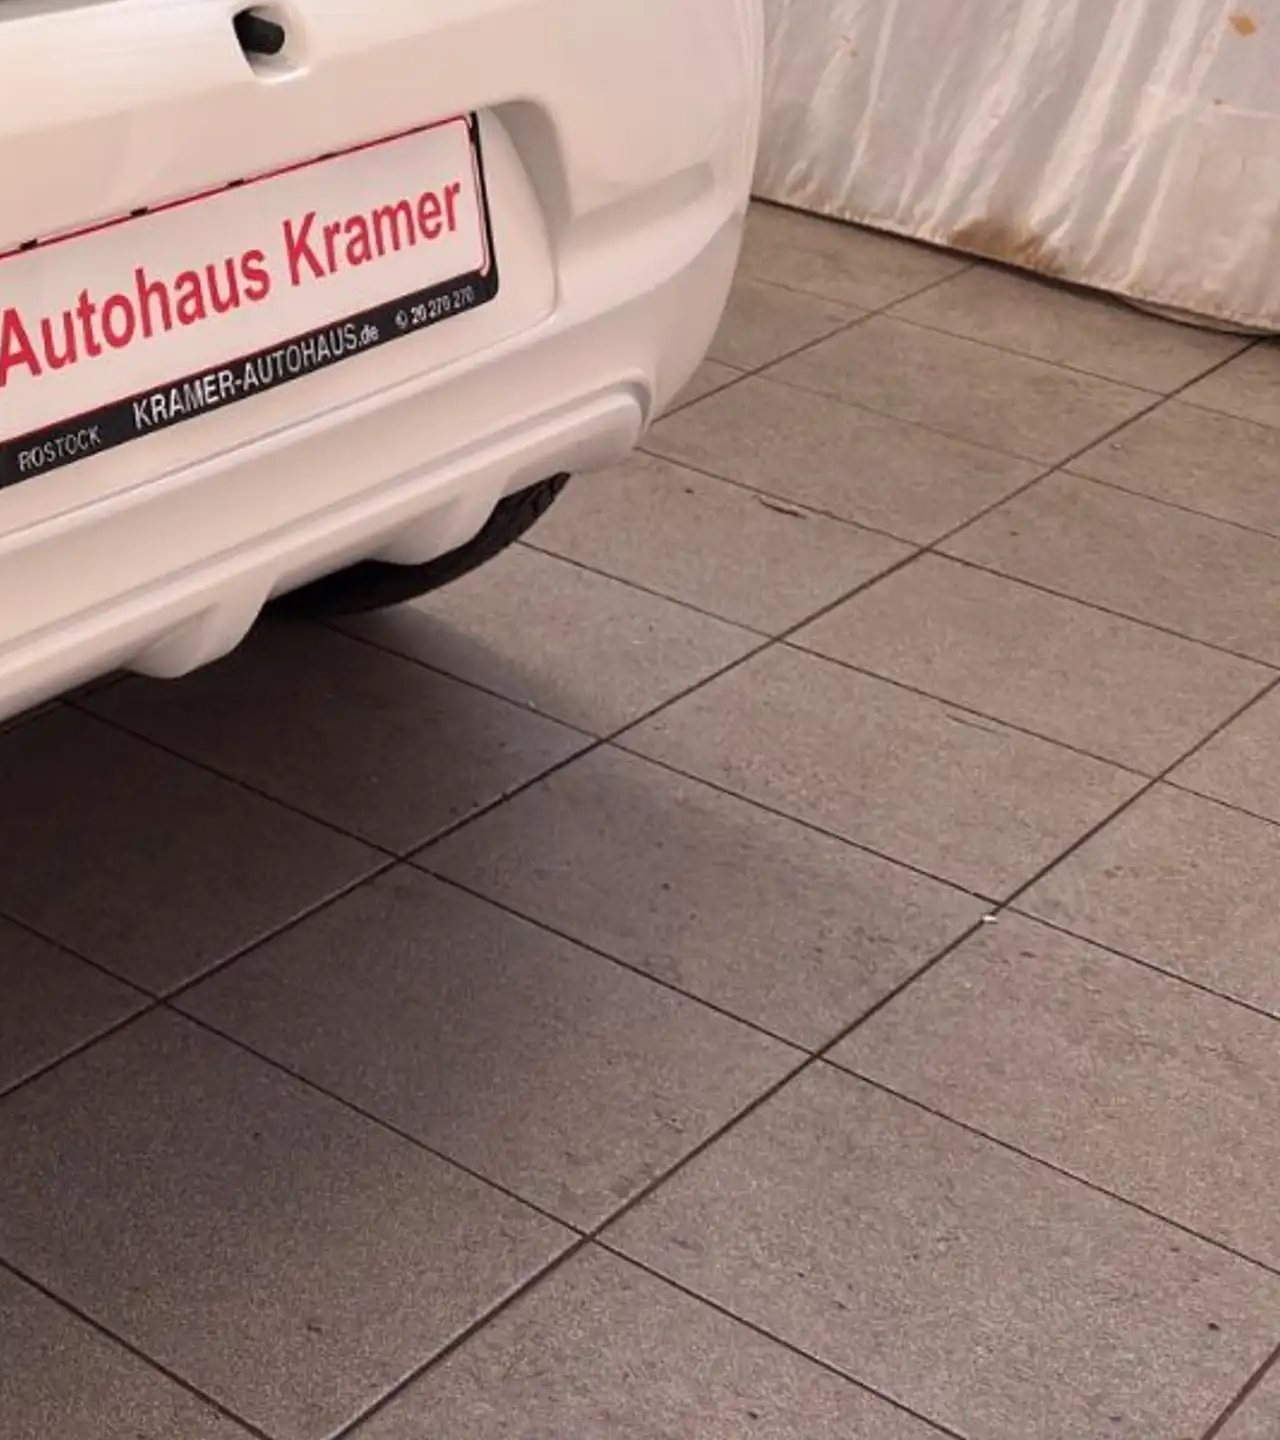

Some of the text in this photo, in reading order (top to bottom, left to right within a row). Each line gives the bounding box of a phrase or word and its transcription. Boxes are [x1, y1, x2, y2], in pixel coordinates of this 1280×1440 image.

[283, 181, 461, 288] Kramer
[17, 425, 102, 474] ROSTOCK
[133, 323, 380, 430] KRAMER-AUTOHAUS.de
[411, 303, 427, 325] 20
[428, 295, 451, 318] 270
